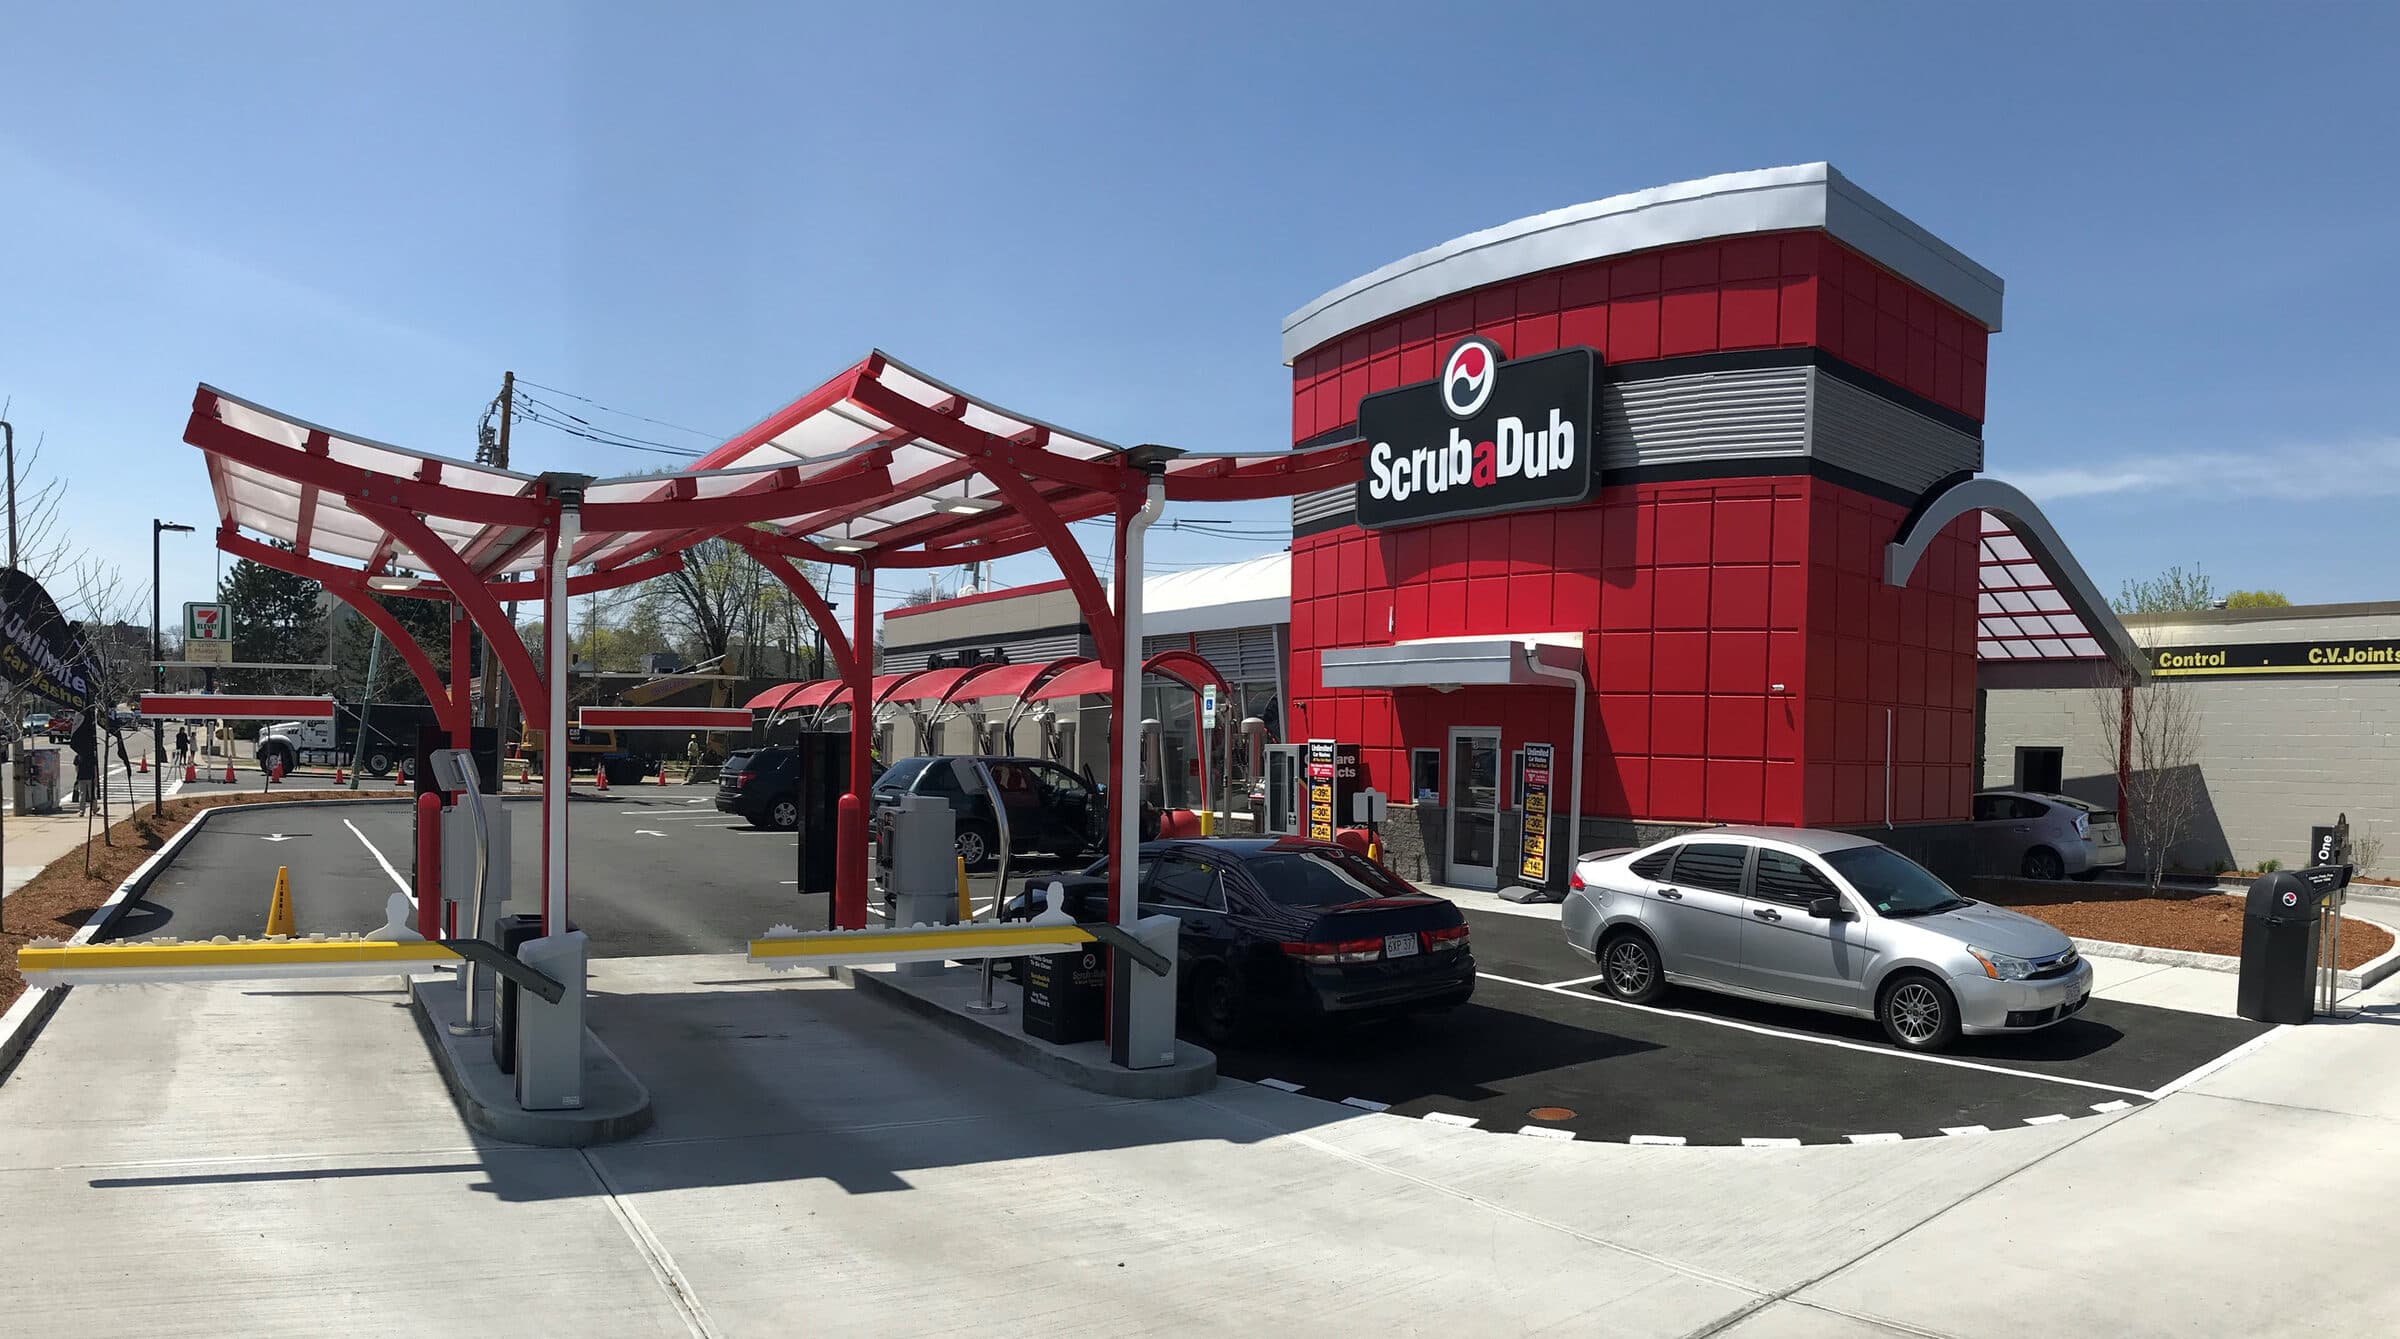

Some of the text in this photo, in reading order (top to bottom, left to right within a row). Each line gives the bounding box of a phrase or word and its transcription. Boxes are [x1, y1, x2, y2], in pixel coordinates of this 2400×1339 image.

[1369, 408, 1575, 502] ScrubaDub
[2159, 650, 2226, 668] Control
[1336, 755, 1355, 764] are
[2319, 835, 2332, 860] One
